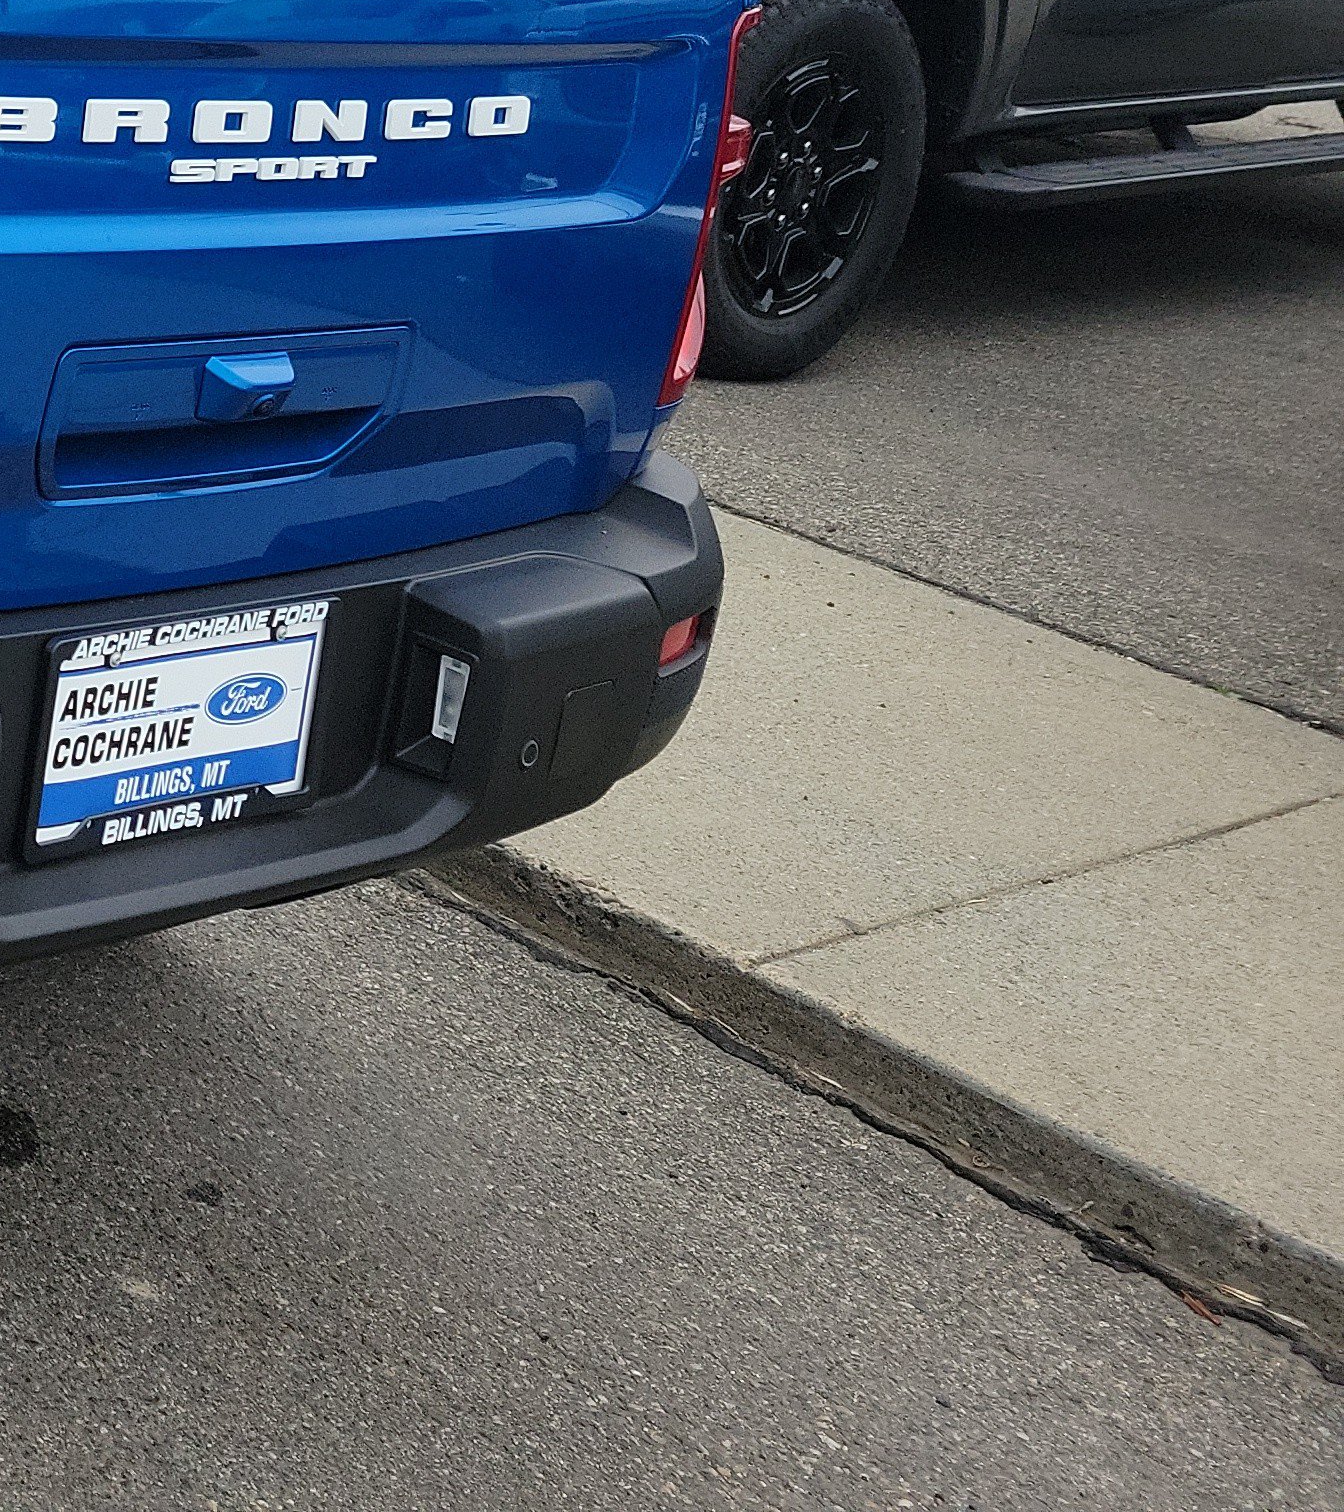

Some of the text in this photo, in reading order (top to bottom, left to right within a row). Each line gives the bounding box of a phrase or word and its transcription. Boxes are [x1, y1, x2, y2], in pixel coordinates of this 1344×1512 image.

[169, 155, 377, 183] SPORT
[72, 601, 329, 662] ARCHIE COCHRANE FORD
[59, 676, 159, 723] ARCHIE
[220, 681, 272, 716] Ford
[52, 716, 195, 770] COCHRANE
[114, 760, 230, 805] BILLINGS, MT
[101, 794, 248, 845] BILLINGS, MT
